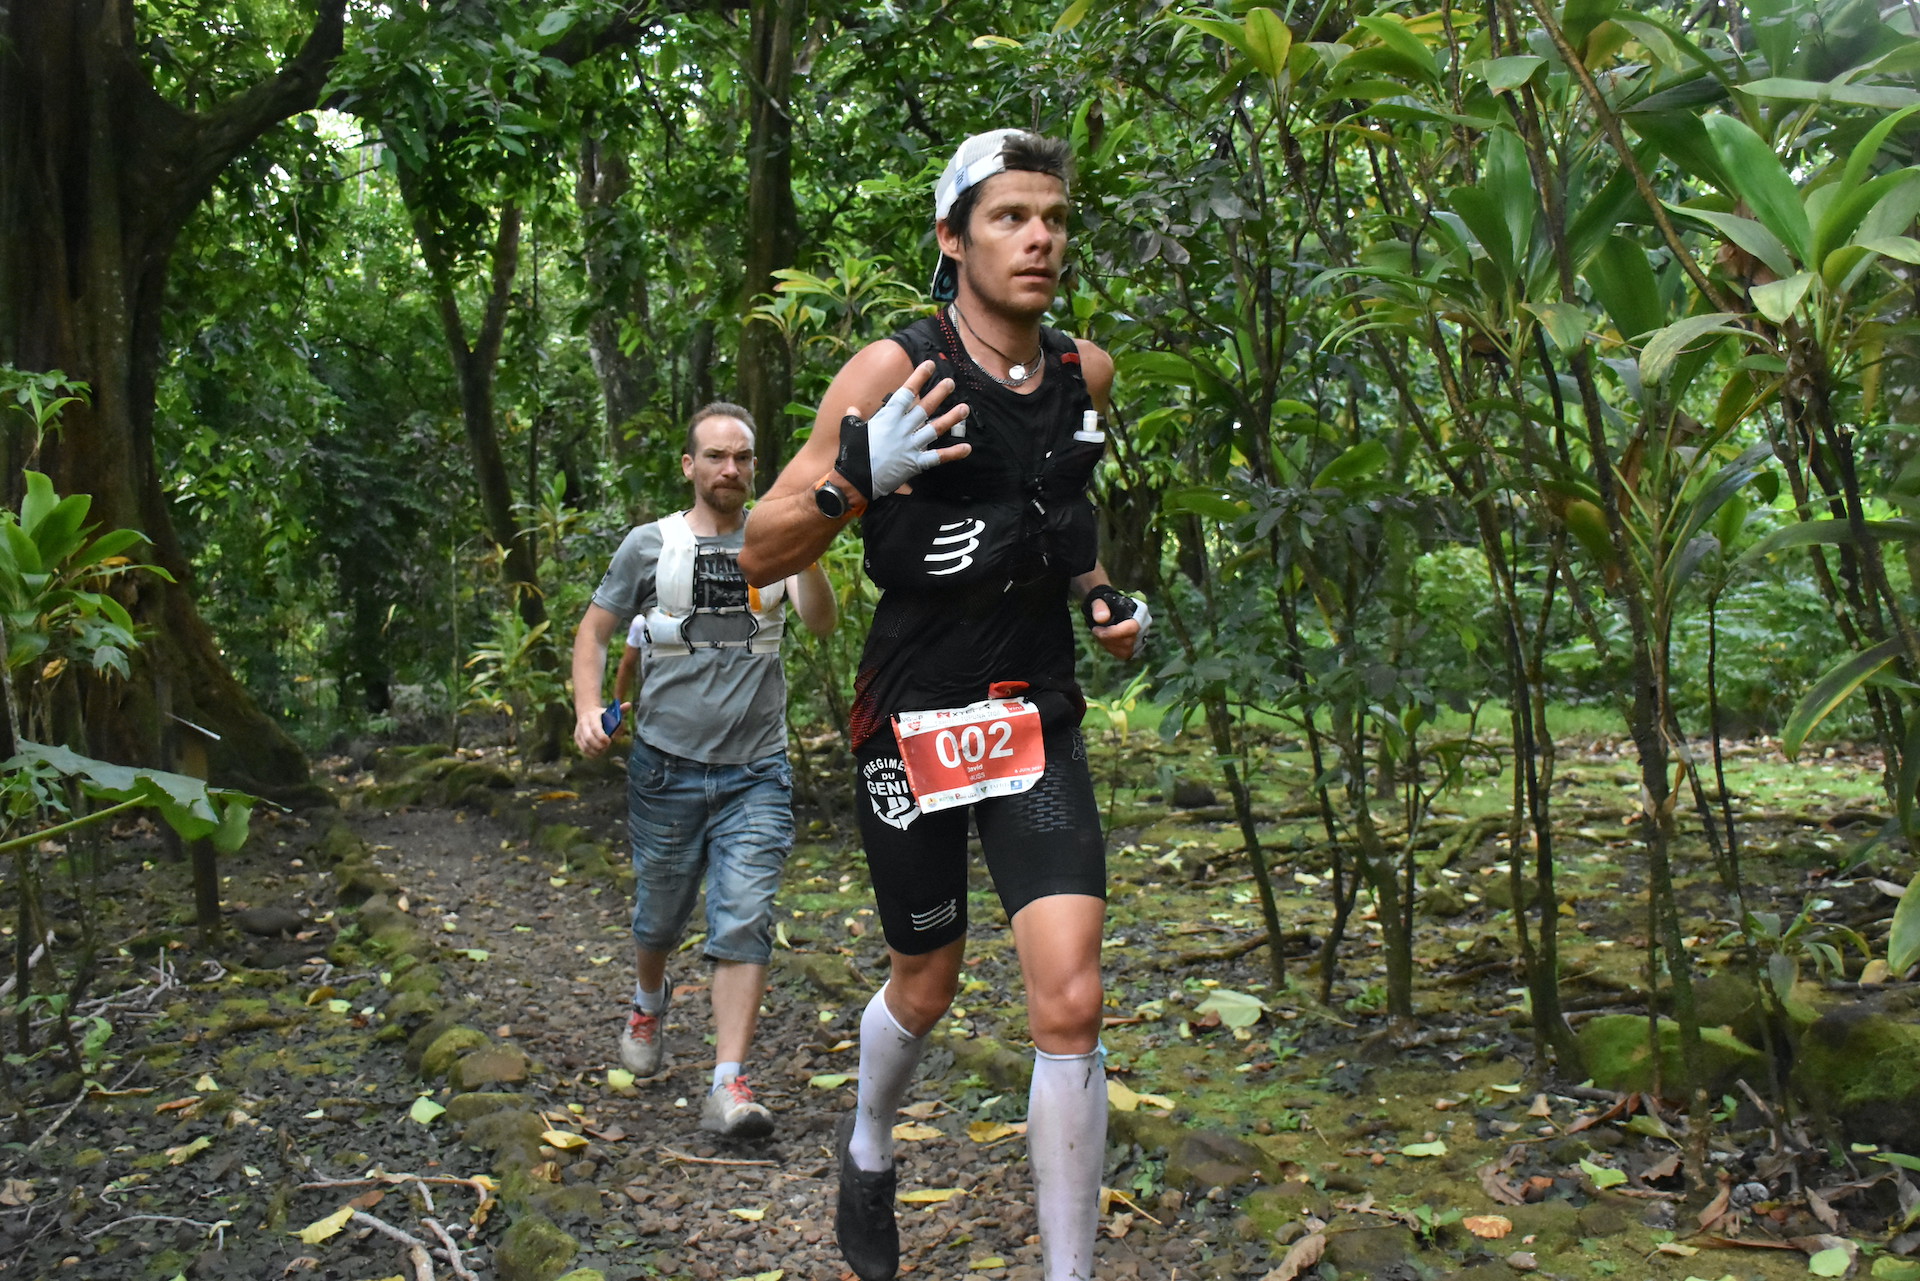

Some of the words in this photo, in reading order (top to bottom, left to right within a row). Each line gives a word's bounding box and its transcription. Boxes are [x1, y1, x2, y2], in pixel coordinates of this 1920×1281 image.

[935, 721, 1014, 769] 002
[881, 772, 896, 780] DU
[866, 780, 909, 796] GENI
